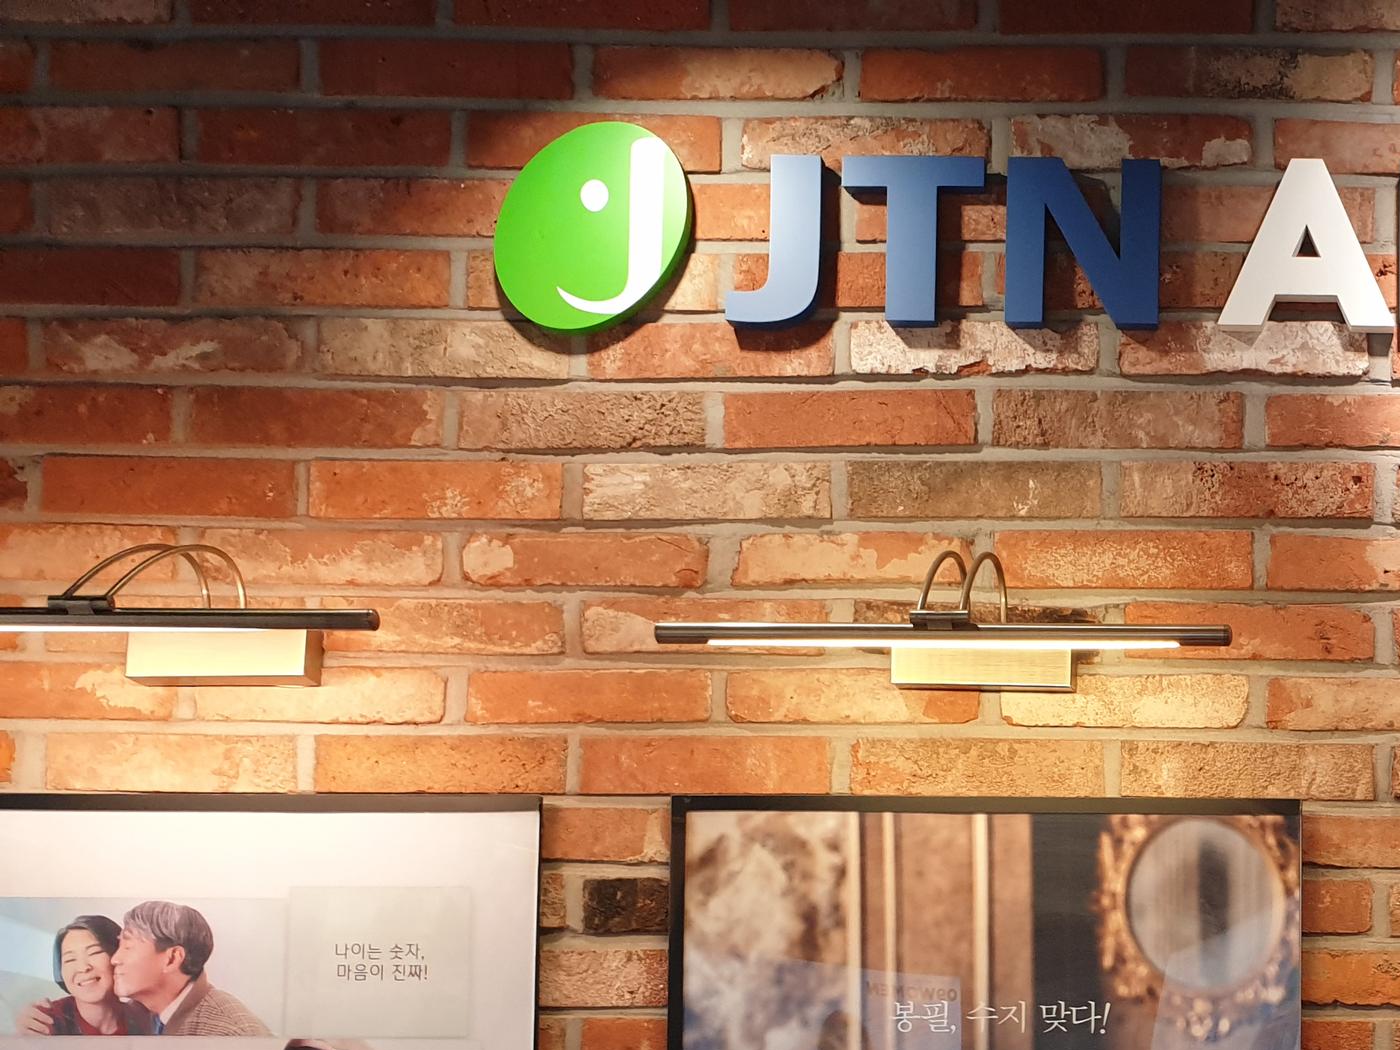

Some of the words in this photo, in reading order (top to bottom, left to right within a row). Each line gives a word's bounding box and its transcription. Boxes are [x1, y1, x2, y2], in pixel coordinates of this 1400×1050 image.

[724, 154, 1162, 330] JTN
[334, 943, 382, 961] 나이는
[336, 963, 384, 981] 마음이
[390, 963, 428, 981] 진짜!
[891, 1001, 957, 1033] 봉필,
[966, 1001, 1029, 1033] 수지
[1040, 1001, 1111, 1034] 맞다!
